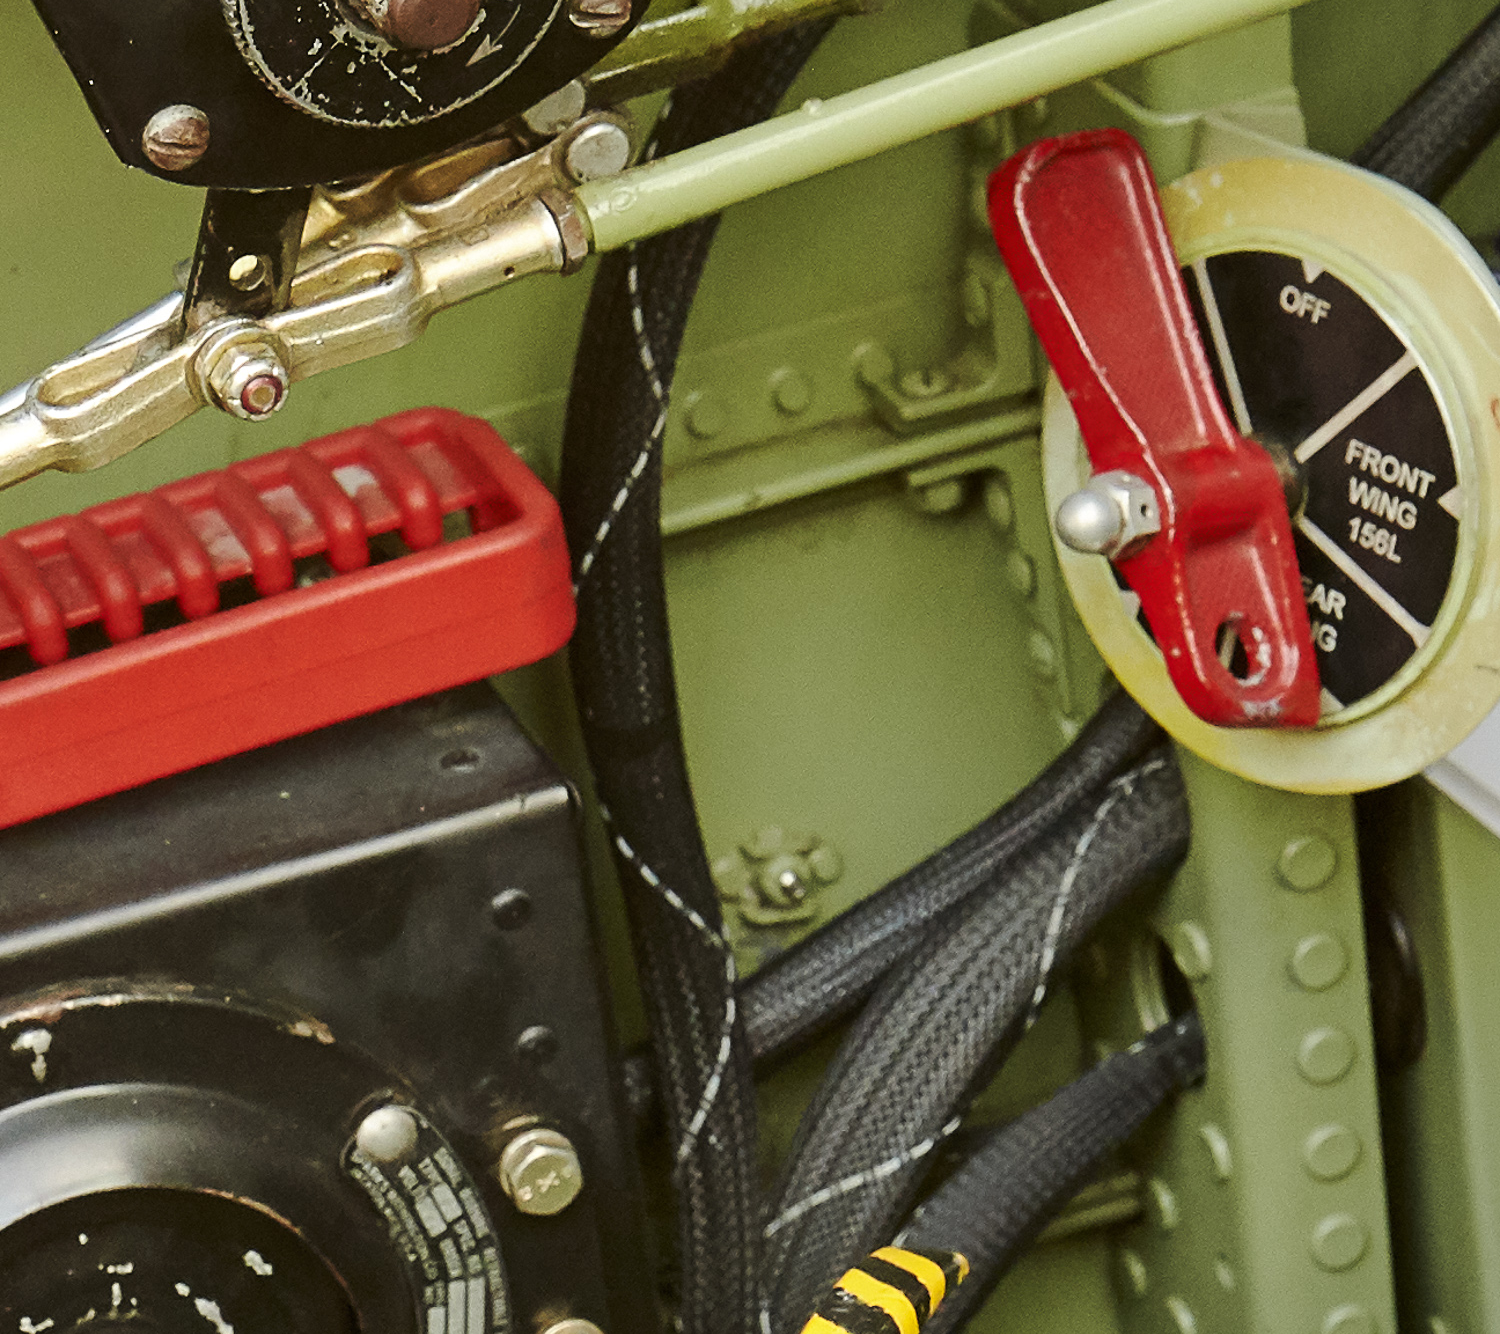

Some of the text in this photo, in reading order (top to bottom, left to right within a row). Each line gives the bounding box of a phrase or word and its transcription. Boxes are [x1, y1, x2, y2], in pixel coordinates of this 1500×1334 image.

[1278, 283, 1333, 326] OFF
[1344, 438, 1437, 500] FRONT
[1347, 475, 1419, 532] WING
